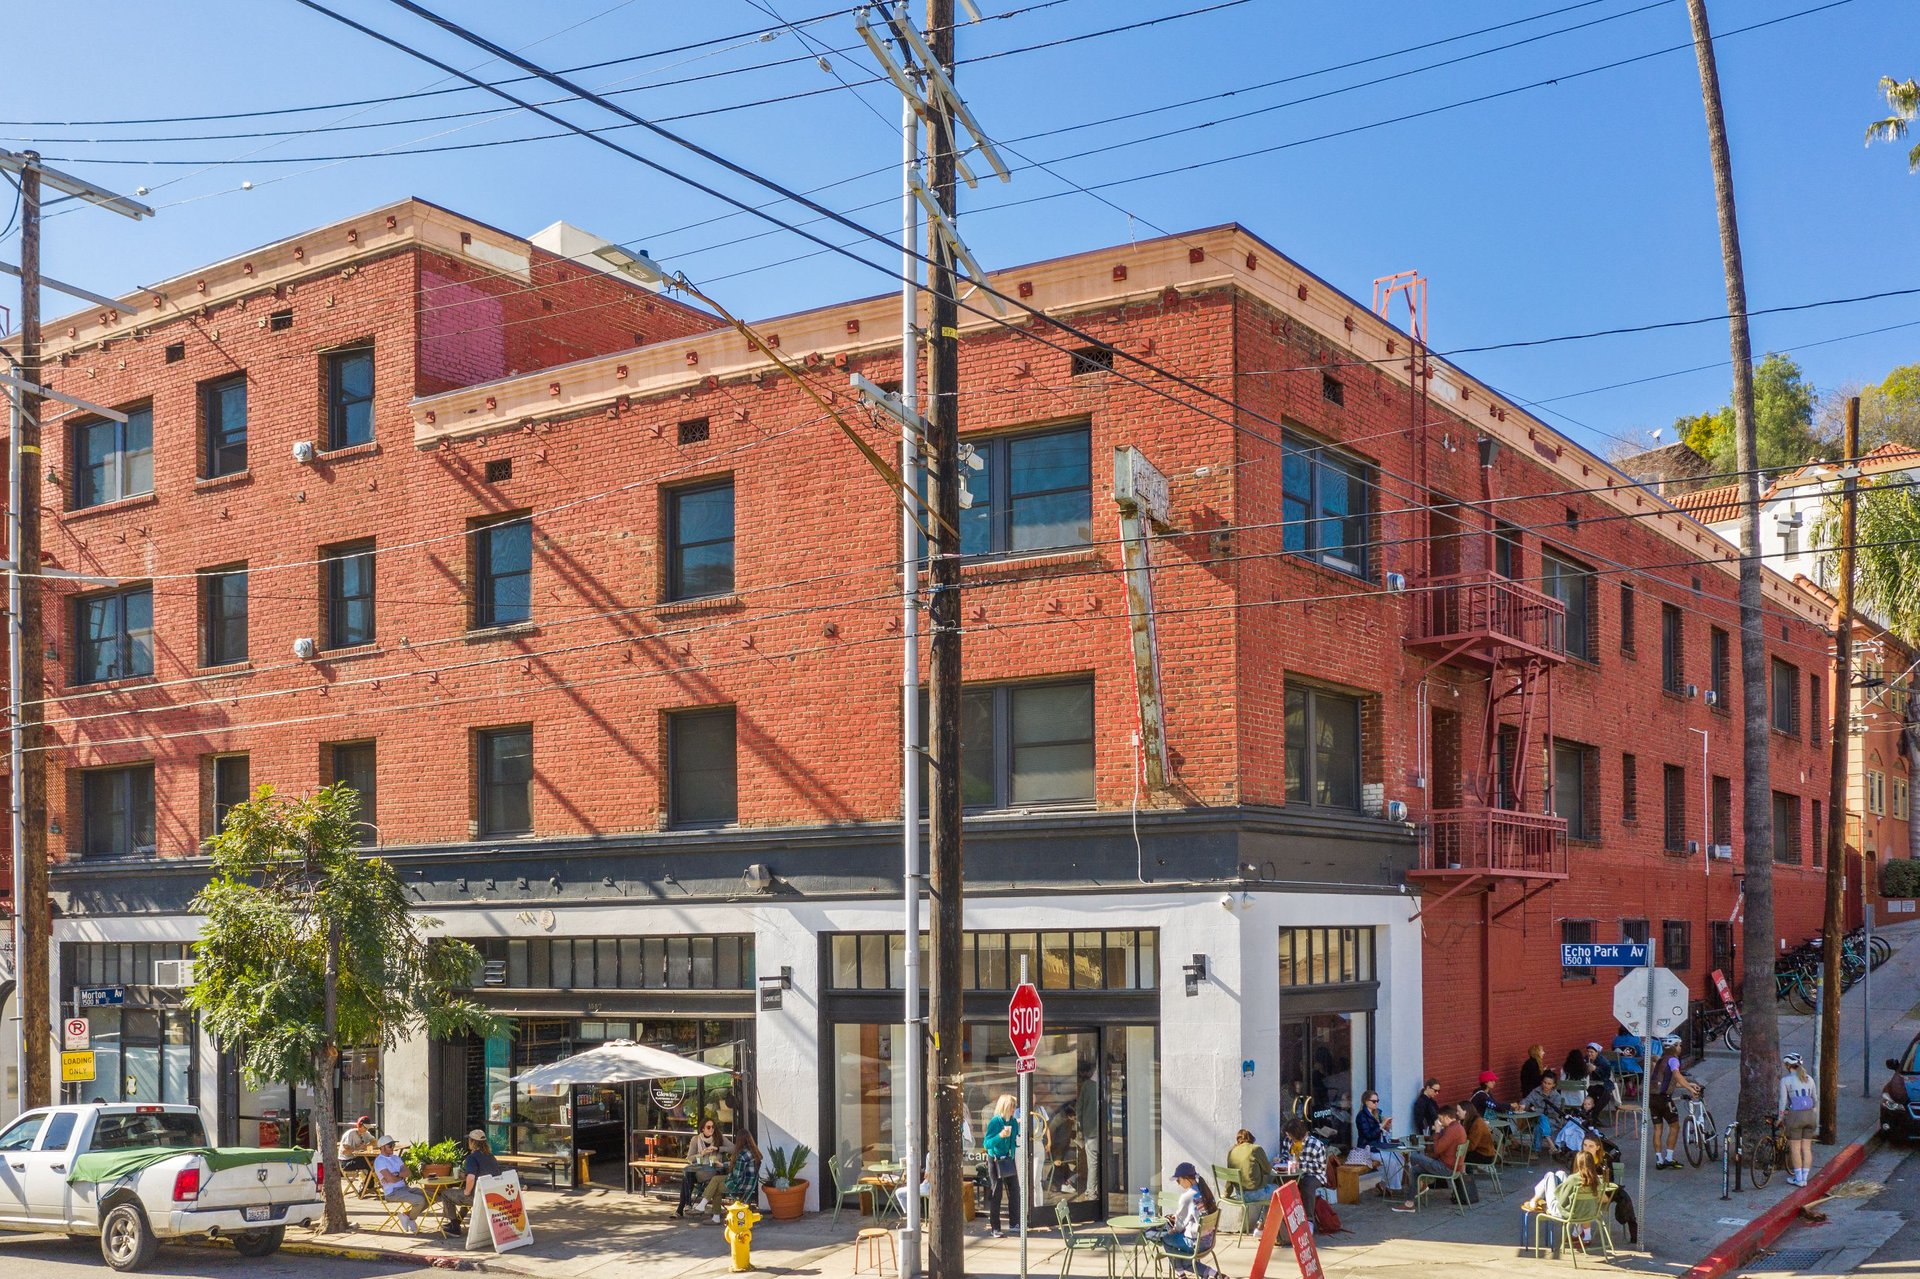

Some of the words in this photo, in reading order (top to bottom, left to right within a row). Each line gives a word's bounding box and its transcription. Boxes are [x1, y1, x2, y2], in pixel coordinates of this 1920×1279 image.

[1565, 946, 1590, 957] Echo
[1594, 946, 1618, 957] Park
[1630, 946, 1644, 957] Av
[82, 990, 106, 1000] Morton
[114, 989, 123, 998] Av
[1012, 1006, 1040, 1036] STOP
[64, 1057, 92, 1066] LOADING
[1314, 1109, 1332, 1118] canyon
[968, 1152, 988, 1161] can
